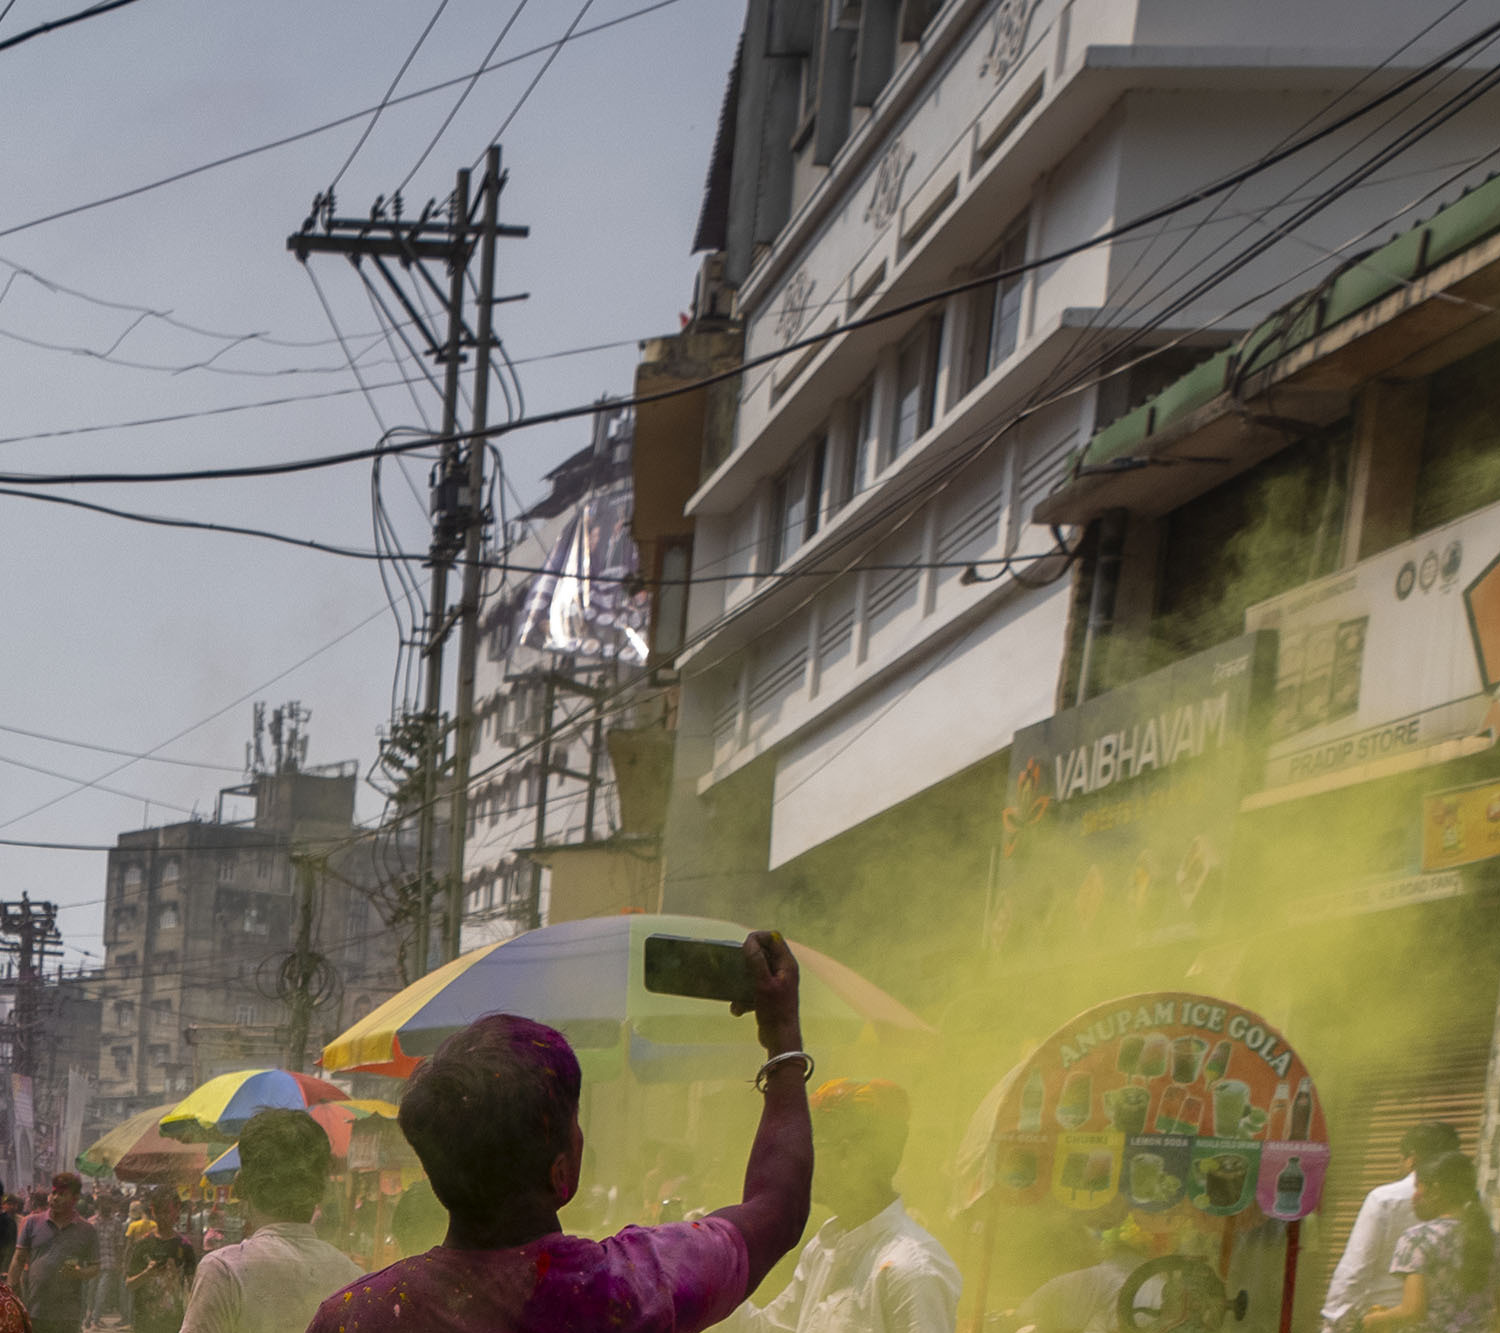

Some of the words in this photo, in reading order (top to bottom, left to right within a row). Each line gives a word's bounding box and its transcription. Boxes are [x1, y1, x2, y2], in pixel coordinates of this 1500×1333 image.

[1055, 690, 1229, 802] VAIBHAVAM
[1288, 740, 1353, 781] PRADIP
[1356, 718, 1422, 760] STORE
[1058, 1001, 1177, 1069] ANUPAM
[1180, 1000, 1228, 1032] ICE
[1228, 1013, 1293, 1078] GOLA
[1130, 1137, 1161, 1147] LEMON
